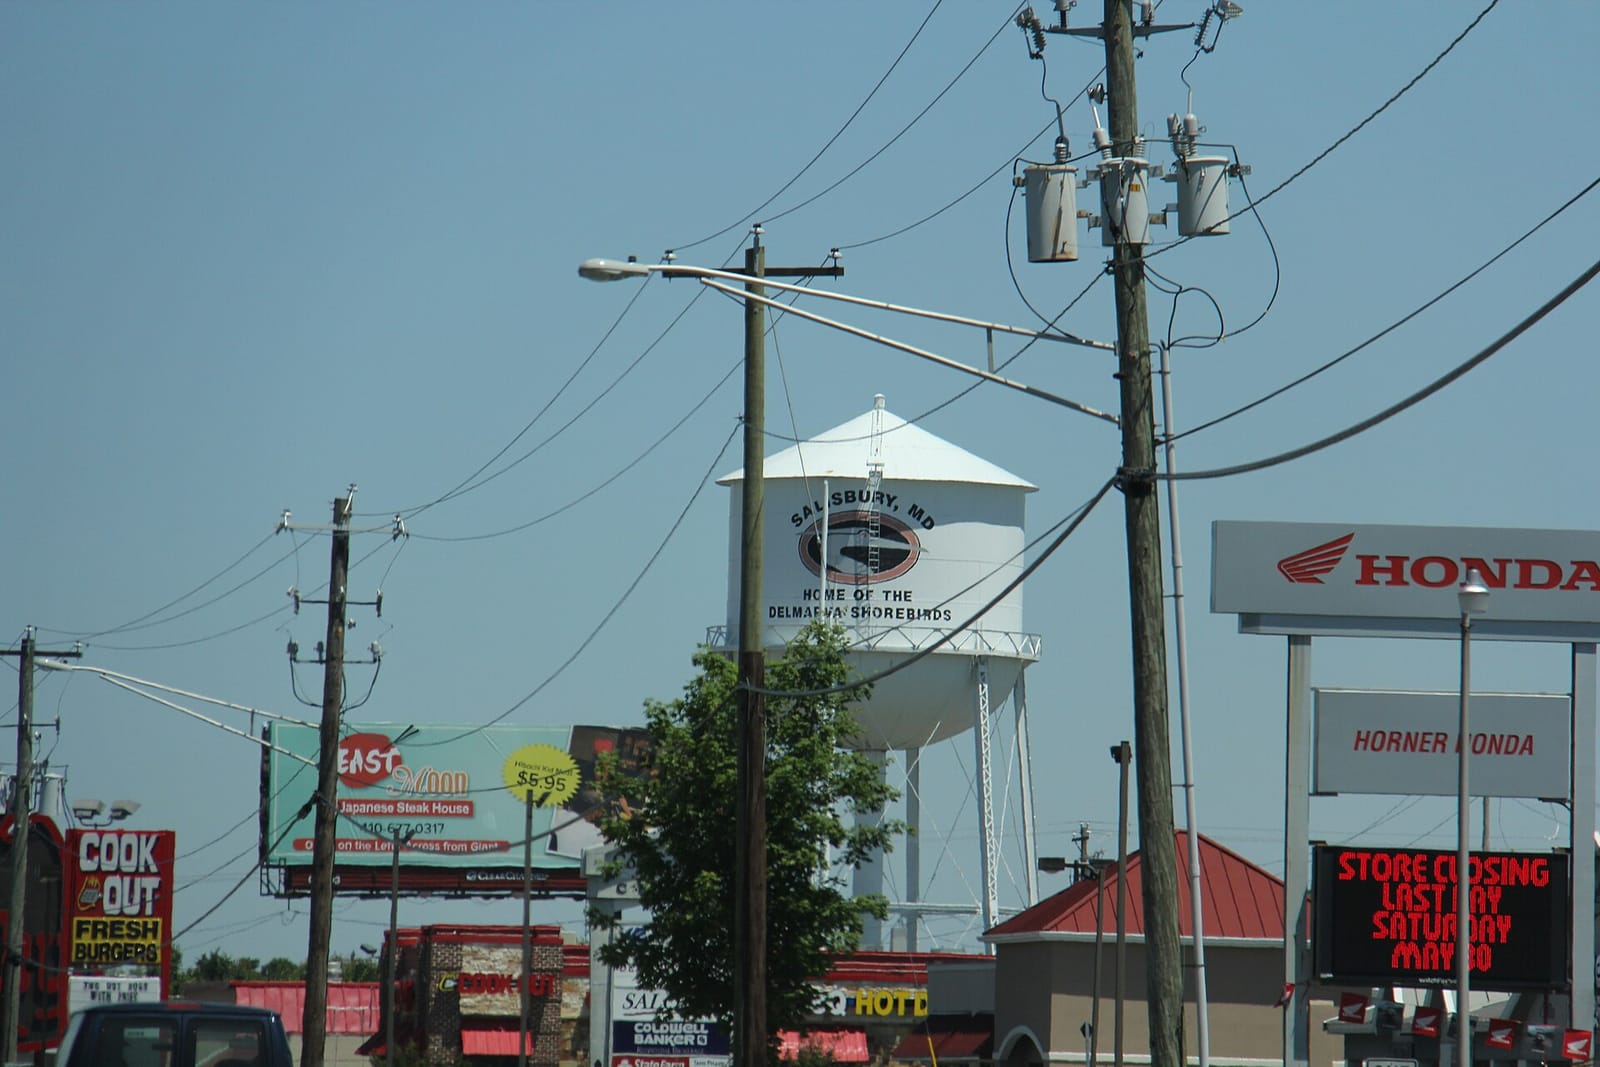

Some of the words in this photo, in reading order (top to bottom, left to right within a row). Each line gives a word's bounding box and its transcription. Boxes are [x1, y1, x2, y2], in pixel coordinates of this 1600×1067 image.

[907, 503, 935, 531] MD
[1355, 555, 1600, 591] HONDA
[803, 588, 845, 601] HOME
[853, 589, 874, 601] OF
[882, 590, 912, 602] THE
[851, 606, 952, 621] SHOREBIRDS
[1354, 730, 1448, 754] HORNER
[337, 746, 400, 775] EAST
[386, 764, 468, 797] Moon
[517, 770, 566, 792] $5.95
[340, 801, 393, 815] Japanese
[396, 801, 429, 814] Steak
[433, 802, 469, 815] House
[80, 832, 158, 873] COOK
[338, 841, 351, 850] on
[355, 840, 371, 850] the
[443, 840, 467, 852] from
[471, 841, 498, 852] Giant
[1338, 851, 1427, 883] STORE
[1434, 854, 1550, 887] CLOSING
[103, 875, 161, 916] OUT
[1382, 882, 1446, 913] LAST
[1452, 884, 1502, 914] AY
[76, 920, 159, 940] FRESH
[75, 942, 158, 961] BURGERS
[1391, 942, 1454, 971] MAY
[458, 972, 513, 994] COOK
[855, 989, 911, 1016] HOT
[634, 1023, 709, 1034] COLDWELL
[634, 1034, 696, 1046] BANKER
